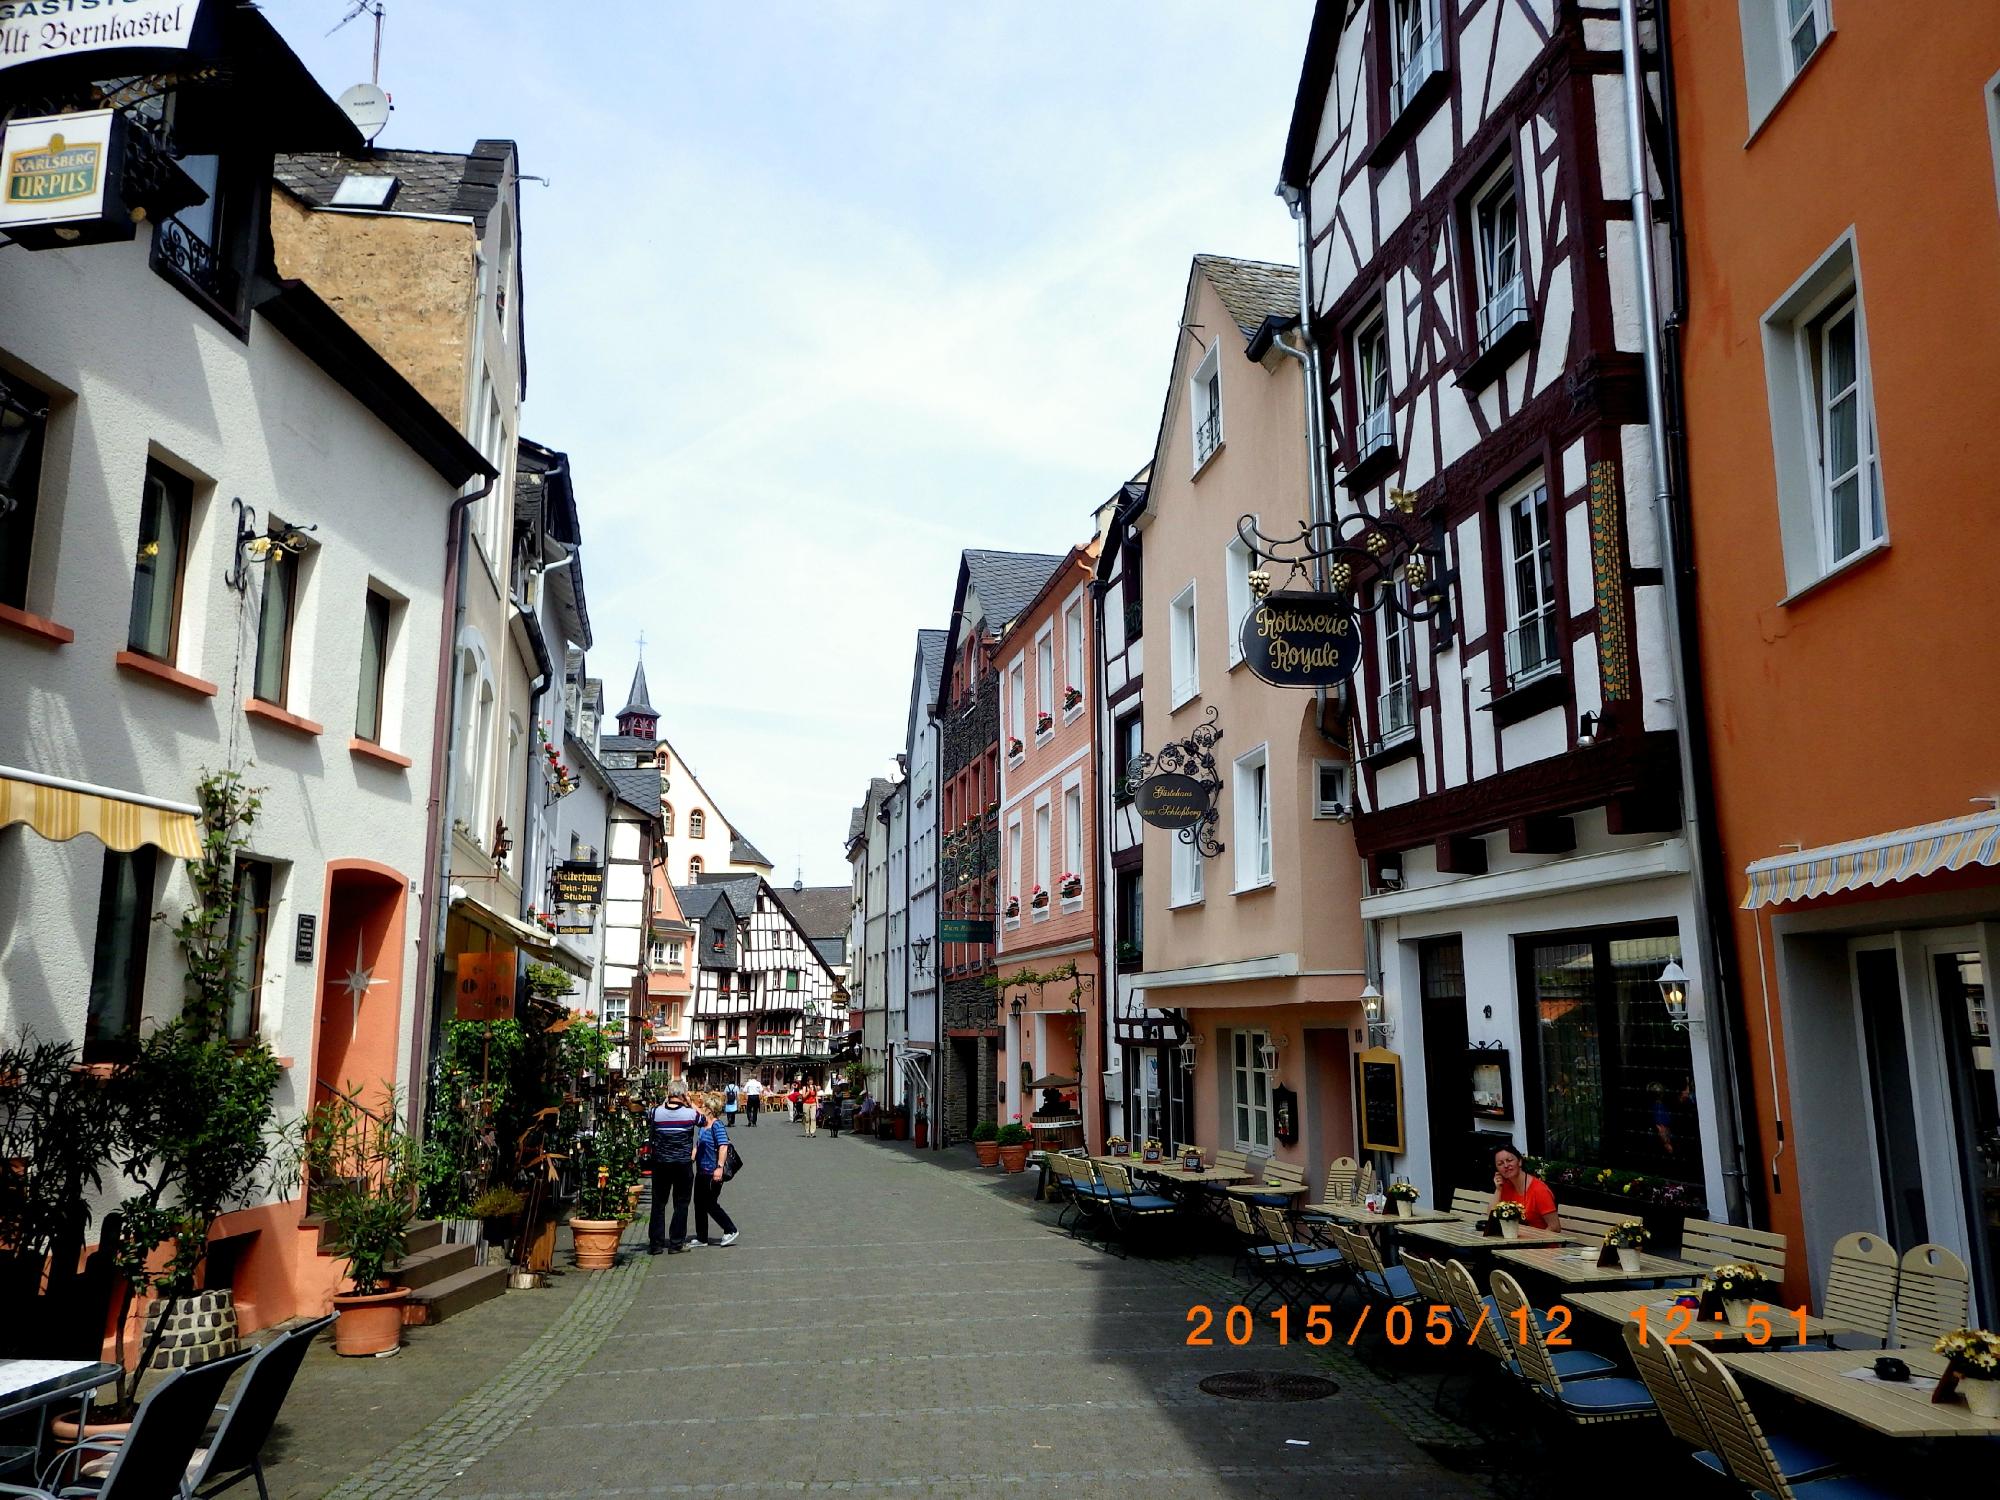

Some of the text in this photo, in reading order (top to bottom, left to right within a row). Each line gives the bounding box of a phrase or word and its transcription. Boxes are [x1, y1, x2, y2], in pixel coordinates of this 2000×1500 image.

[40, 3, 184, 49] Bernkastel
[14, 151, 94, 172] KARLSBERG
[1268, 636, 1339, 674] Royale
[563, 892, 592, 901] Stuben
